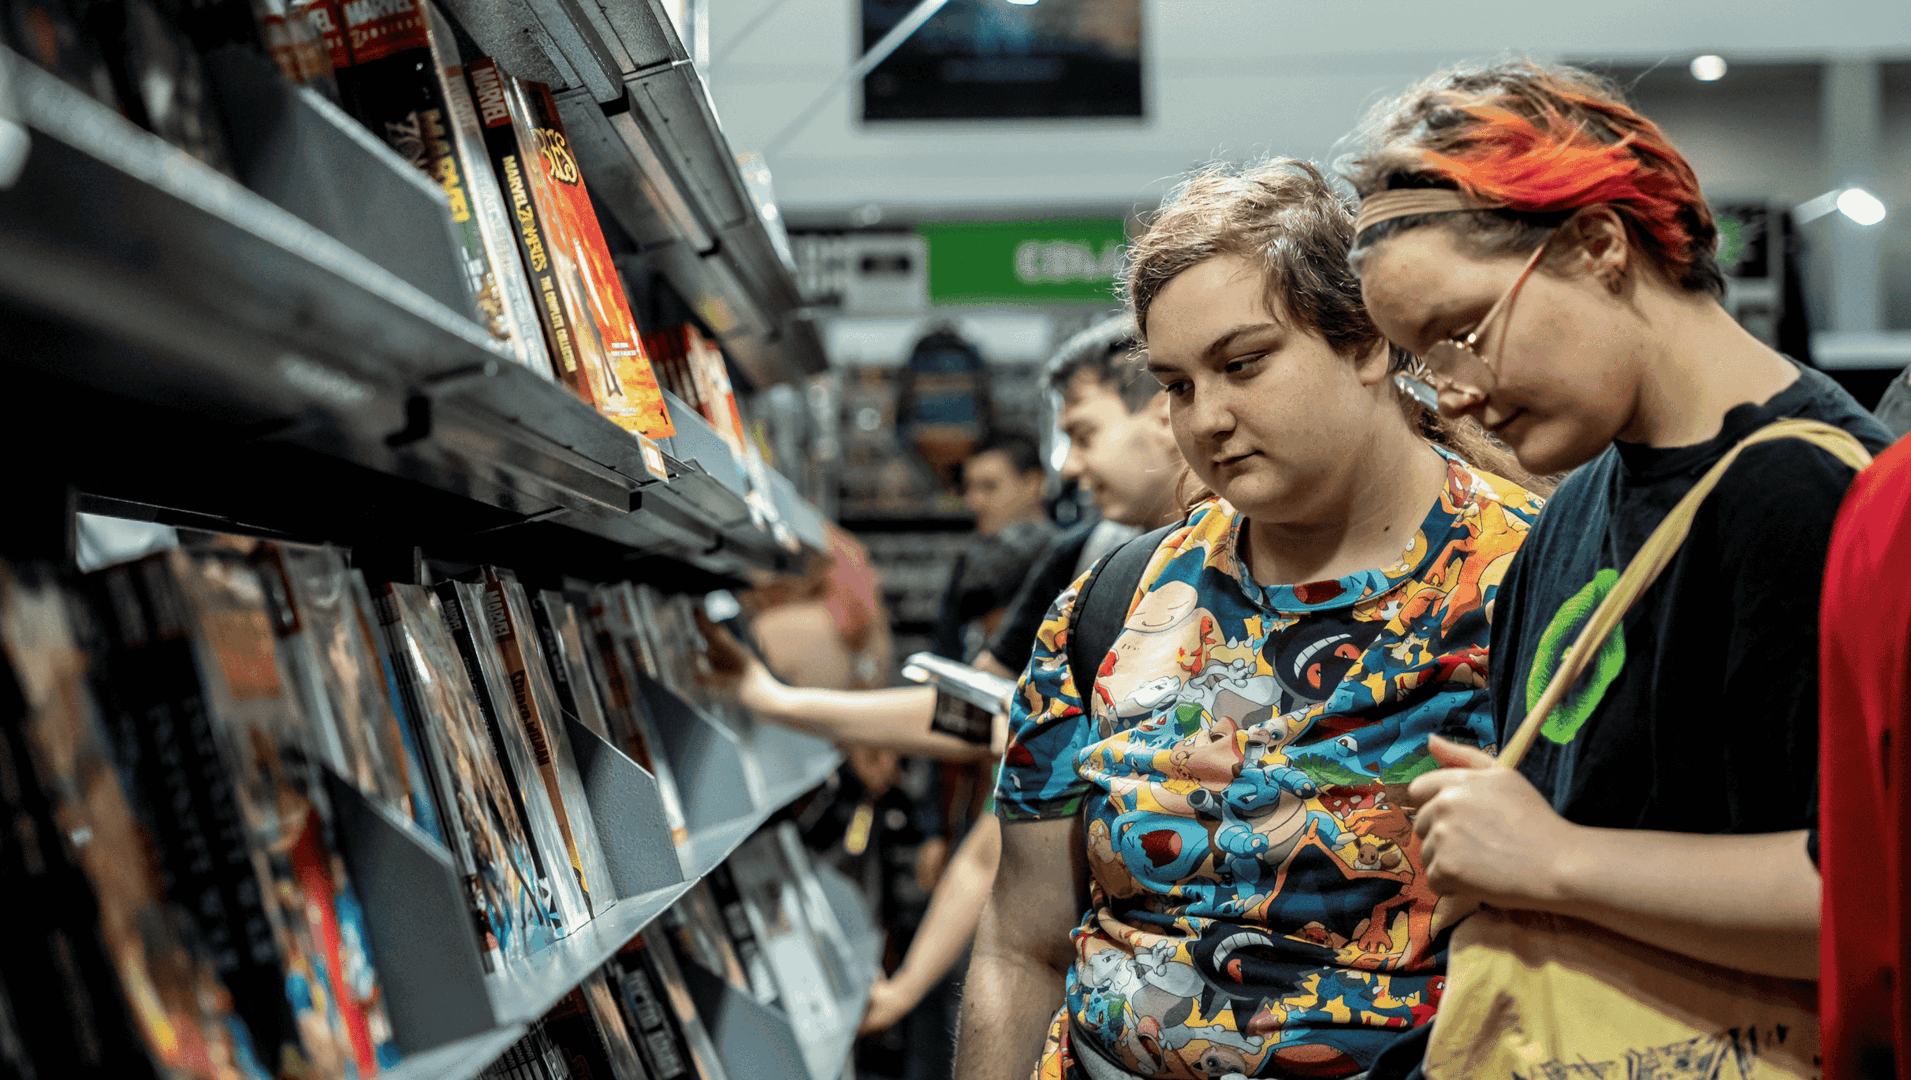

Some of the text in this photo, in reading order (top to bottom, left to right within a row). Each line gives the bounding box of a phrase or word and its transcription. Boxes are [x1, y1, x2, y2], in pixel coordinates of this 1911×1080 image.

[471, 66, 508, 125] MARVEL
[502, 155, 578, 373] MARVEL ZOMBIES THE COMPLETE COLLECTION
[445, 599, 463, 632] MARVEL
[486, 590, 511, 639] MARVEL
[520, 1036, 535, 1061] MARVEL
